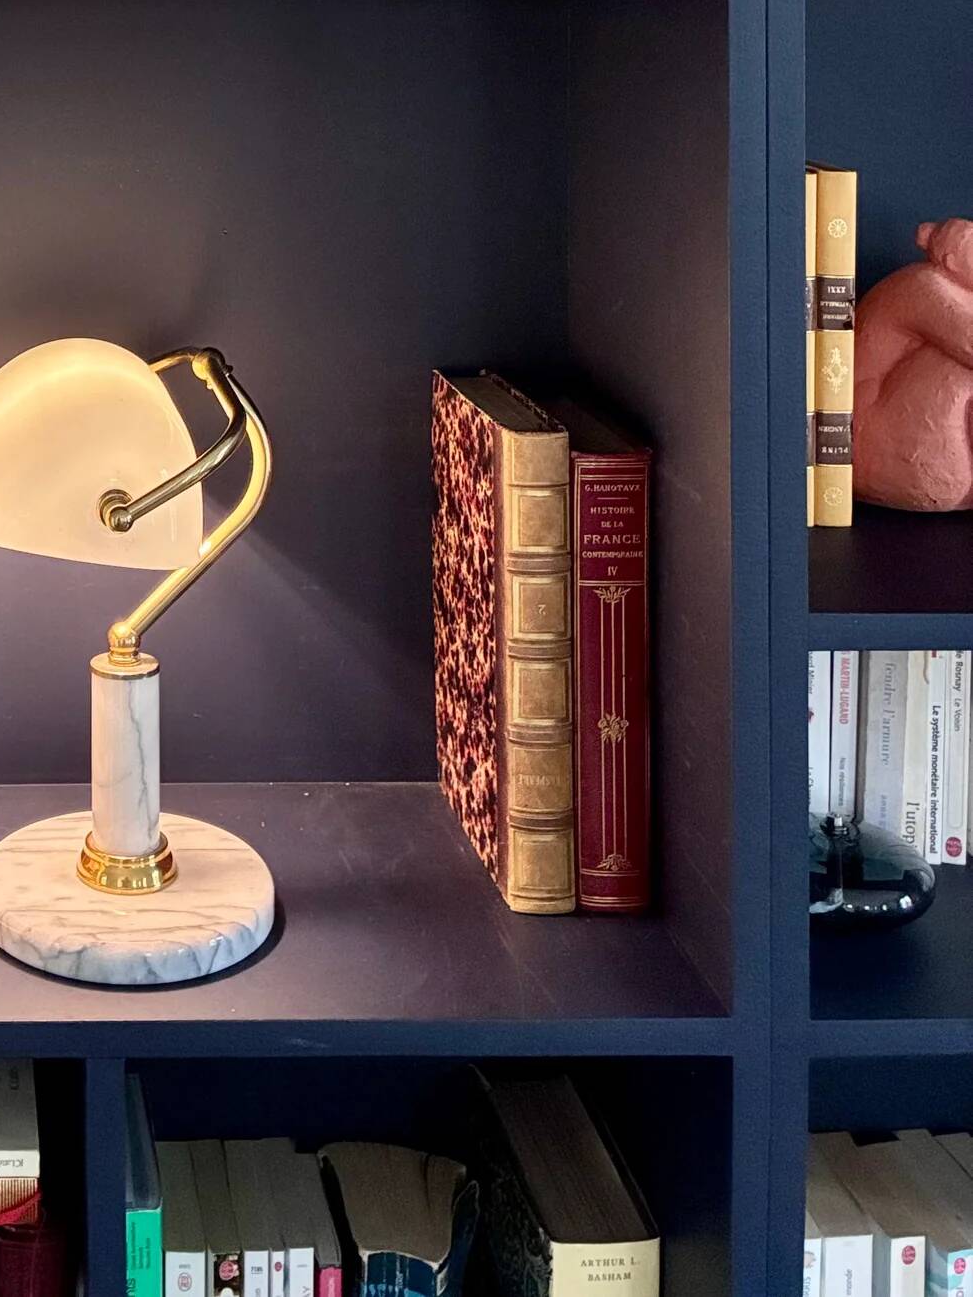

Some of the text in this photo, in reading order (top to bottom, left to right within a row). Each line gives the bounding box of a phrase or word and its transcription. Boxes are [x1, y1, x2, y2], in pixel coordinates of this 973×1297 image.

[590, 506, 635, 515] HISTOIRE
[601, 520, 624, 528] DE LA
[583, 533, 641, 545] FRANCE
[582, 550, 644, 559] CONTEMPORAINE
[607, 565, 618, 577] IV
[952, 662, 964, 692] Rosnay
[839, 657, 851, 725] MARTIN-LUGAND
[881, 708, 896, 766] l'armure
[928, 705, 941, 854] Le système monétaire international
[581, 1256, 641, 1268] ARTHUR L.
[587, 1271, 632, 1282] BASHAM
